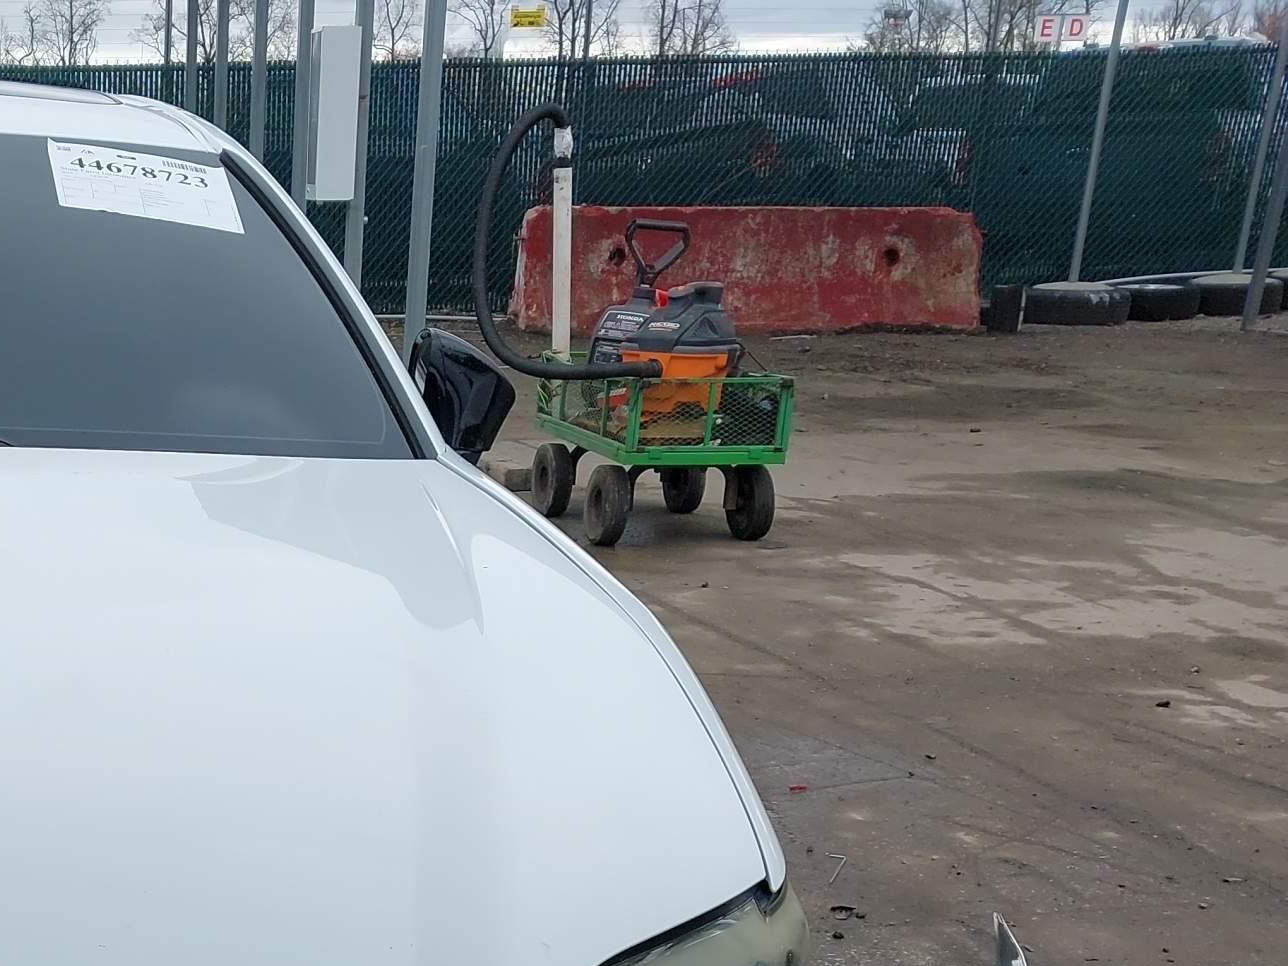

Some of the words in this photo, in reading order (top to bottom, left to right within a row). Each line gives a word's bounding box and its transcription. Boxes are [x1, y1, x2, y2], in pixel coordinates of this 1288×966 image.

[1040, 19, 1055, 36] E
[1069, 19, 1084, 36] D
[70, 157, 209, 189] 44678723
